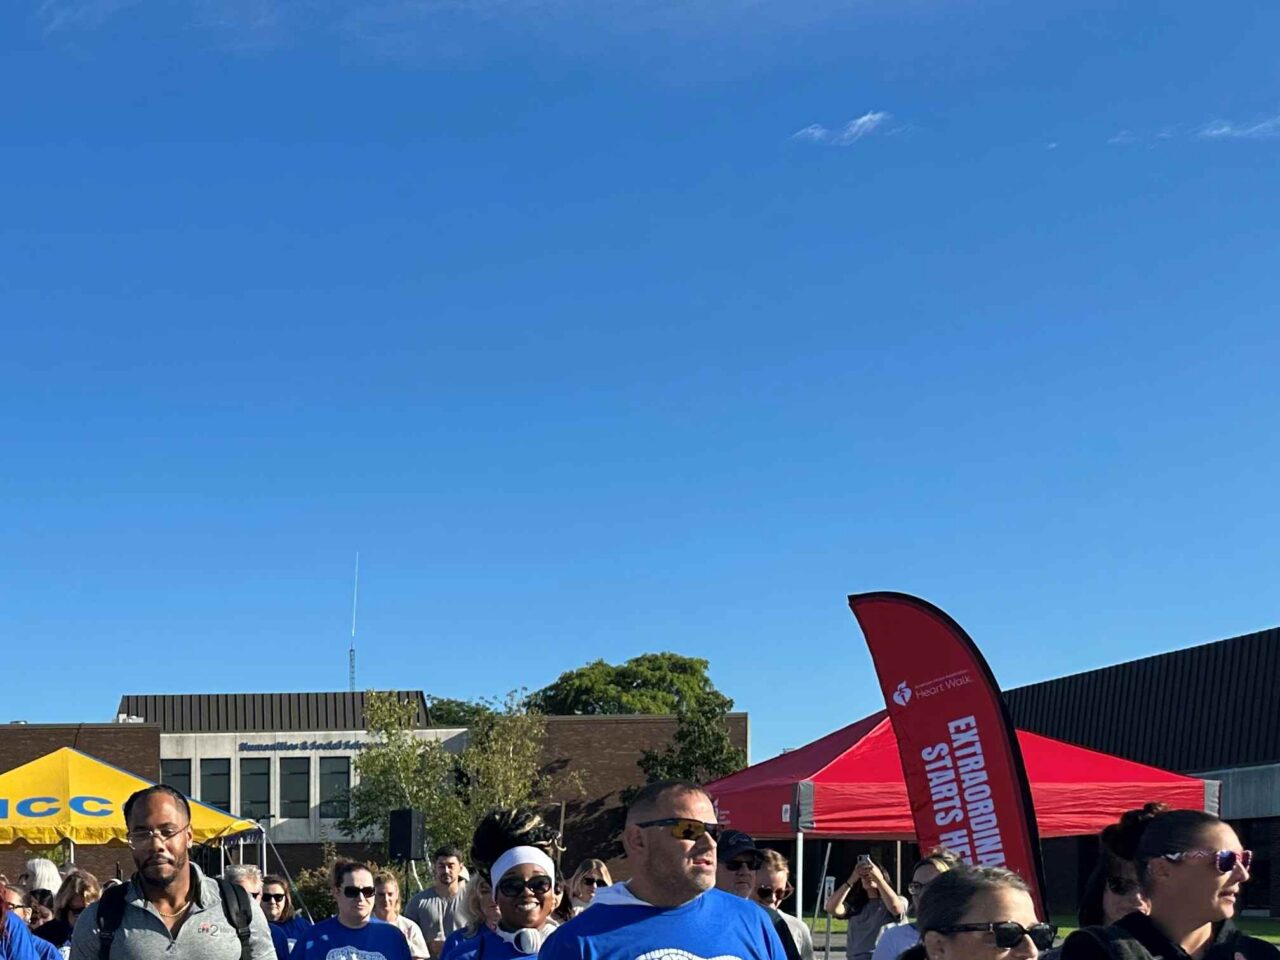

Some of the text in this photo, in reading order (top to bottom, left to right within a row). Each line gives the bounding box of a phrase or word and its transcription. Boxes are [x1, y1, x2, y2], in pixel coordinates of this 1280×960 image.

[915, 683, 944, 699] Heart
[945, 674, 970, 689] Walk
[921, 742, 974, 867] STARTS HE
